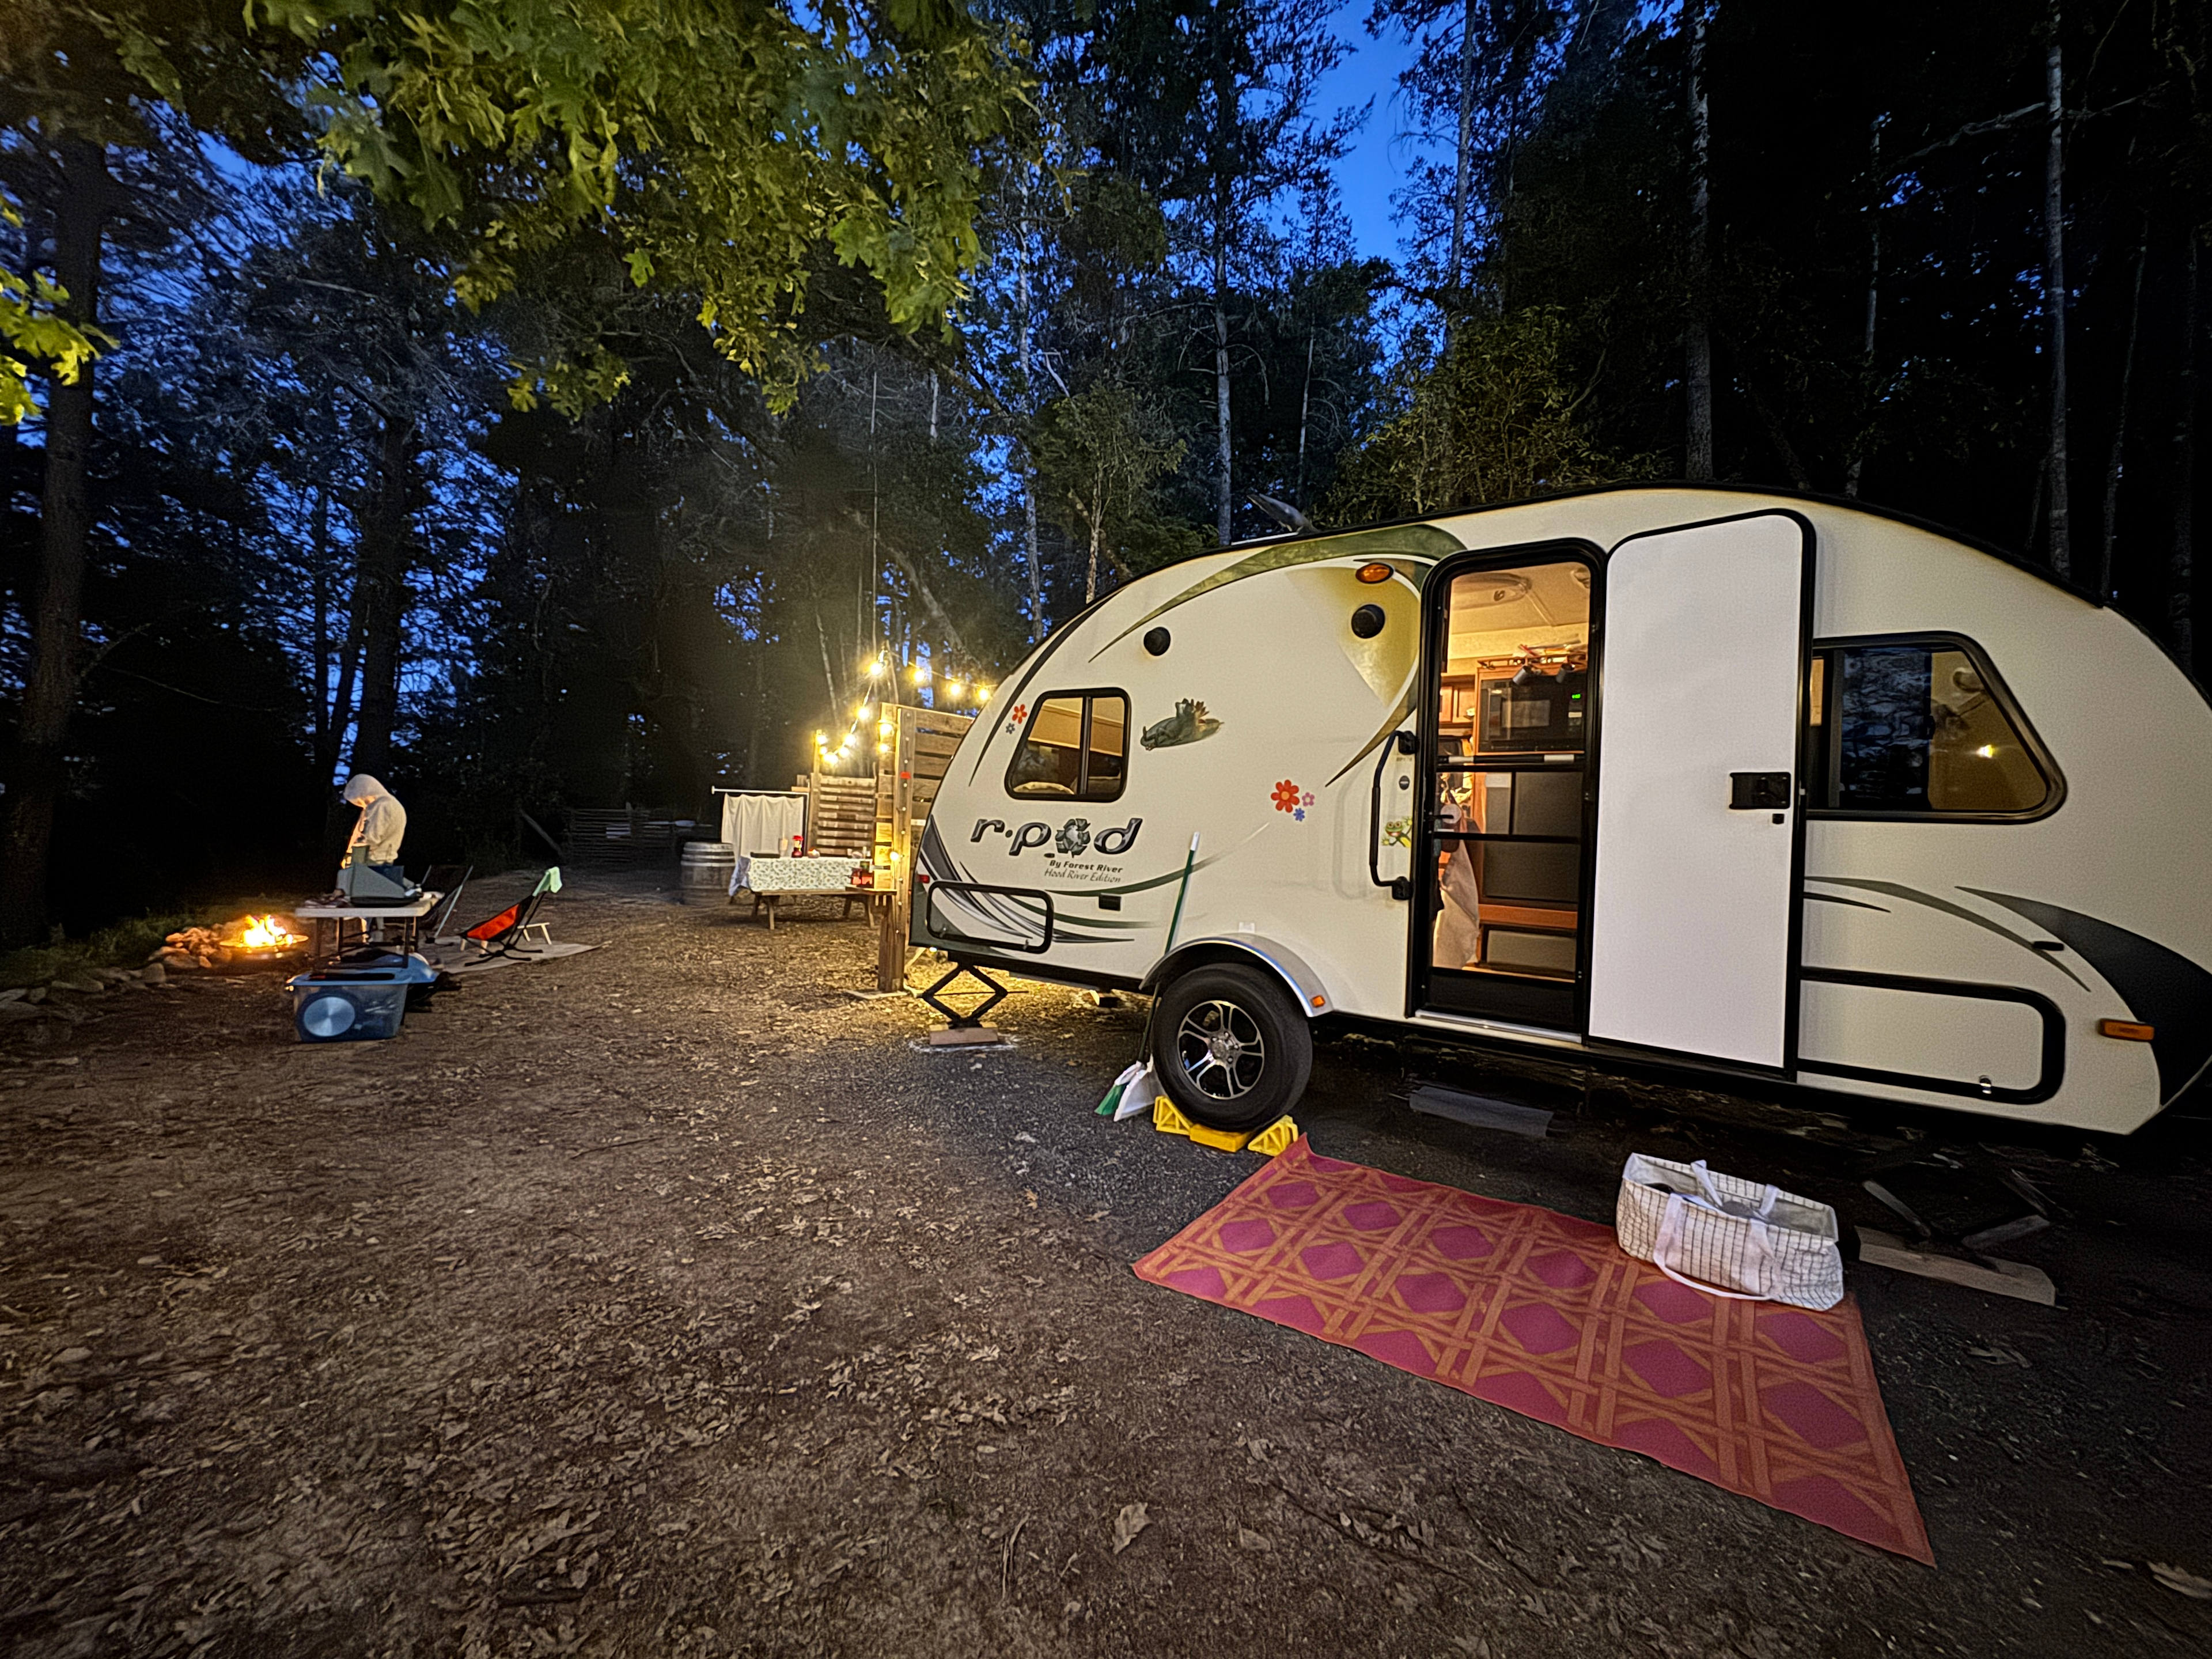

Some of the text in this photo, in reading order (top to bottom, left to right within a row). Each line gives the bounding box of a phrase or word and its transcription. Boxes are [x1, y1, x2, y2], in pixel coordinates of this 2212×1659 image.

[1049, 860, 1123, 873] By Forest River
[1044, 868, 1121, 882] Hood River Edition
